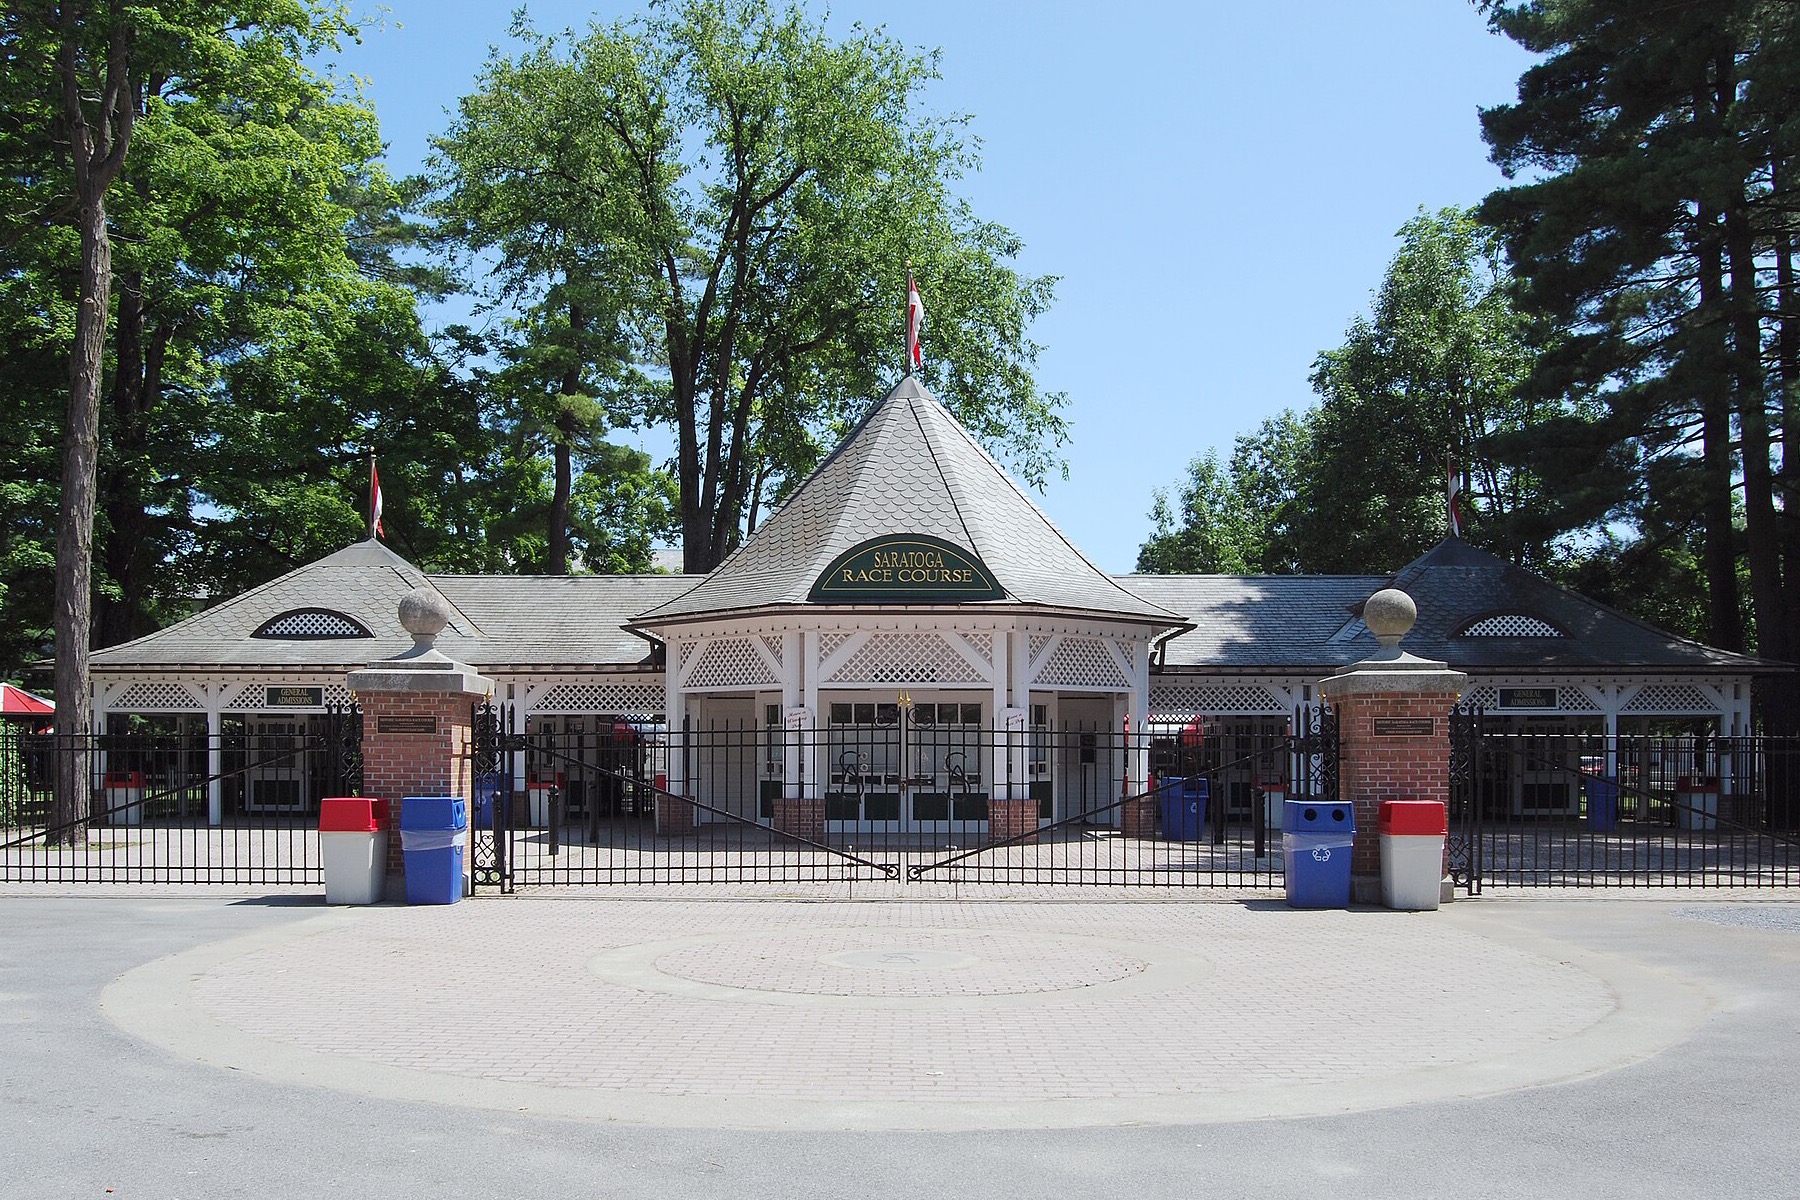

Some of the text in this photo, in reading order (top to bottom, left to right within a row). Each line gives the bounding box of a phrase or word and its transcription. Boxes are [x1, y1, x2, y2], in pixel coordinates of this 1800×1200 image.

[874, 551, 944, 568] SARATOGA
[842, 569, 973, 582] RACE COURSE
[281, 688, 308, 696] GENERAL
[1513, 690, 1542, 698] GENERAL
[1510, 698, 1547, 706] ADMISSIONS
